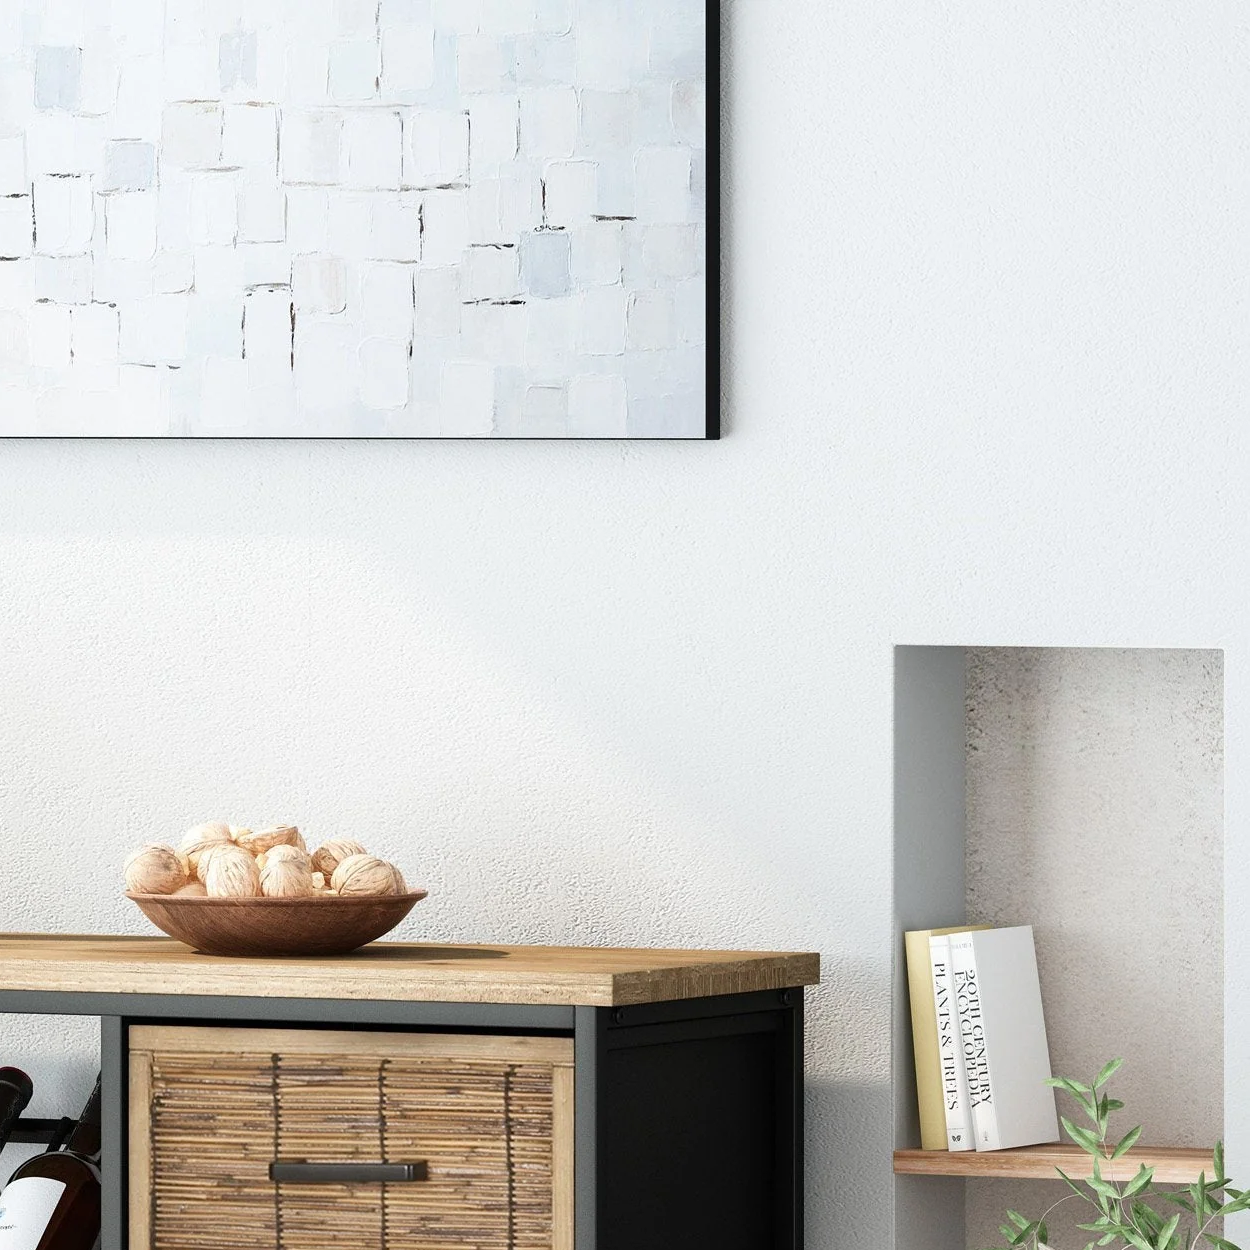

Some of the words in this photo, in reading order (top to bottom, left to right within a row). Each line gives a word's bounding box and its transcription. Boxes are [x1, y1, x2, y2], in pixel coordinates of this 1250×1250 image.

[934, 963, 952, 1031] PLANTS
[941, 1035, 953, 1048] &
[954, 971, 982, 1109] ENCYCLOPEDIA
[973, 1025, 992, 1104] CENTURY
[941, 1053, 959, 1110] TREES
